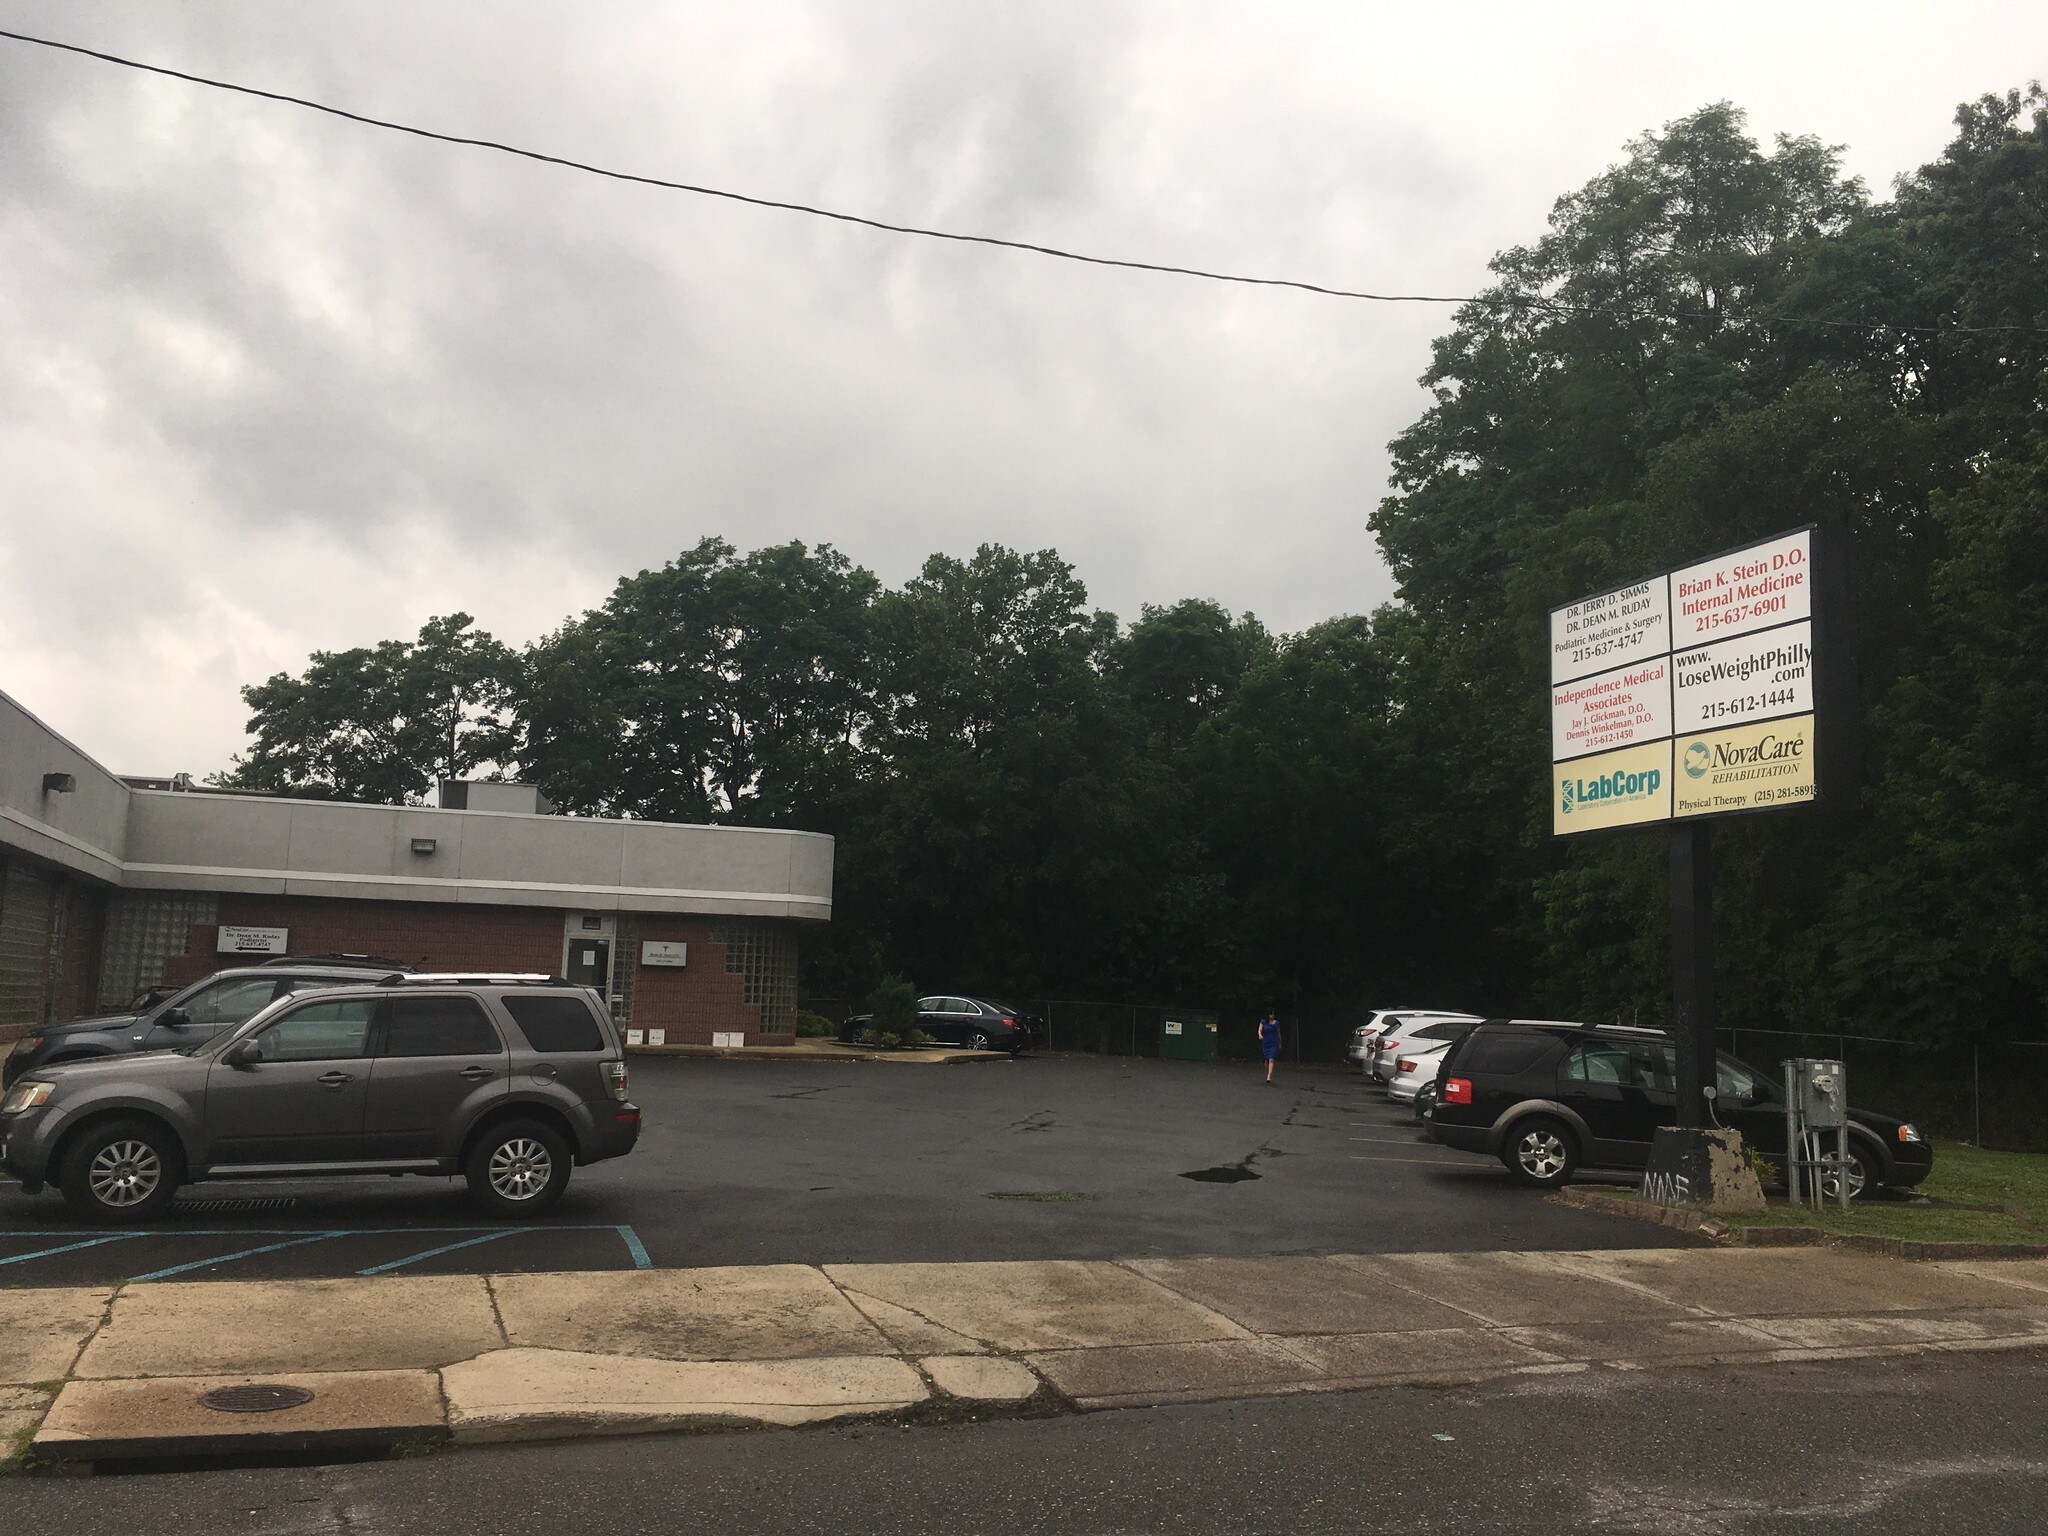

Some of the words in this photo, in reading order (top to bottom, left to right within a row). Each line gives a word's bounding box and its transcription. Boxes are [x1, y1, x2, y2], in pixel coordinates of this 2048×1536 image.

[1680, 579, 1712, 598] Brian
[1716, 571, 1729, 587] K.
[1733, 560, 1768, 582] Stein
[1772, 548, 1806, 571] D.O.
[1566, 608, 1581, 619] DR.
[1583, 597, 1606, 615] JERRY
[1608, 594, 1618, 606] D.
[1620, 583, 1650, 601] SIMMS
[1682, 588, 1733, 616] Internal
[1737, 572, 1803, 601] Medicine
[1566, 623, 1580, 634] DR.
[1583, 612, 1606, 629] DEAN
[1608, 609, 1619, 620] M.
[1622, 597, 1651, 616] RUDAY
[1696, 594, 1786, 632] 215-637-6901
[1555, 636, 1586, 653] Podiatric
[1588, 626, 1623, 643] Medicine
[1624, 623, 1631, 631] &
[1632, 613, 1662, 630] Surgery
[1572, 631, 1644, 663] 215-637-4747
[1676, 651, 1711, 668] www.
[1678, 643, 1812, 688] LoseWeightPhilly
[1771, 666, 1804, 684] .com
[1554, 680, 1620, 706] Independence
[1624, 665, 1664, 688] Medical
[1572, 719, 1582, 730] Jay
[1584, 717, 1588, 727] J.
[1590, 709, 1626, 724] Glickman,
[1628, 703, 1646, 714] D.O.
[1583, 693, 1632, 713] Associates
[1702, 688, 1794, 720] 215-612-1444
[1566, 728, 1590, 740] Dennis
[1591, 719, 1634, 735] Winkelman,
[1636, 712, 1654, 724] D.O.
[1586, 729, 1634, 747] 215-612-1450
[1711, 735, 1804, 768] NovaCare
[1577, 769, 1660, 802] LabCorp
[1712, 763, 1800, 784] REHABILITATION
[1679, 797, 1711, 812] Physical
[1714, 795, 1748, 806] Therapy
[1754, 790, 1774, 804] (215)
